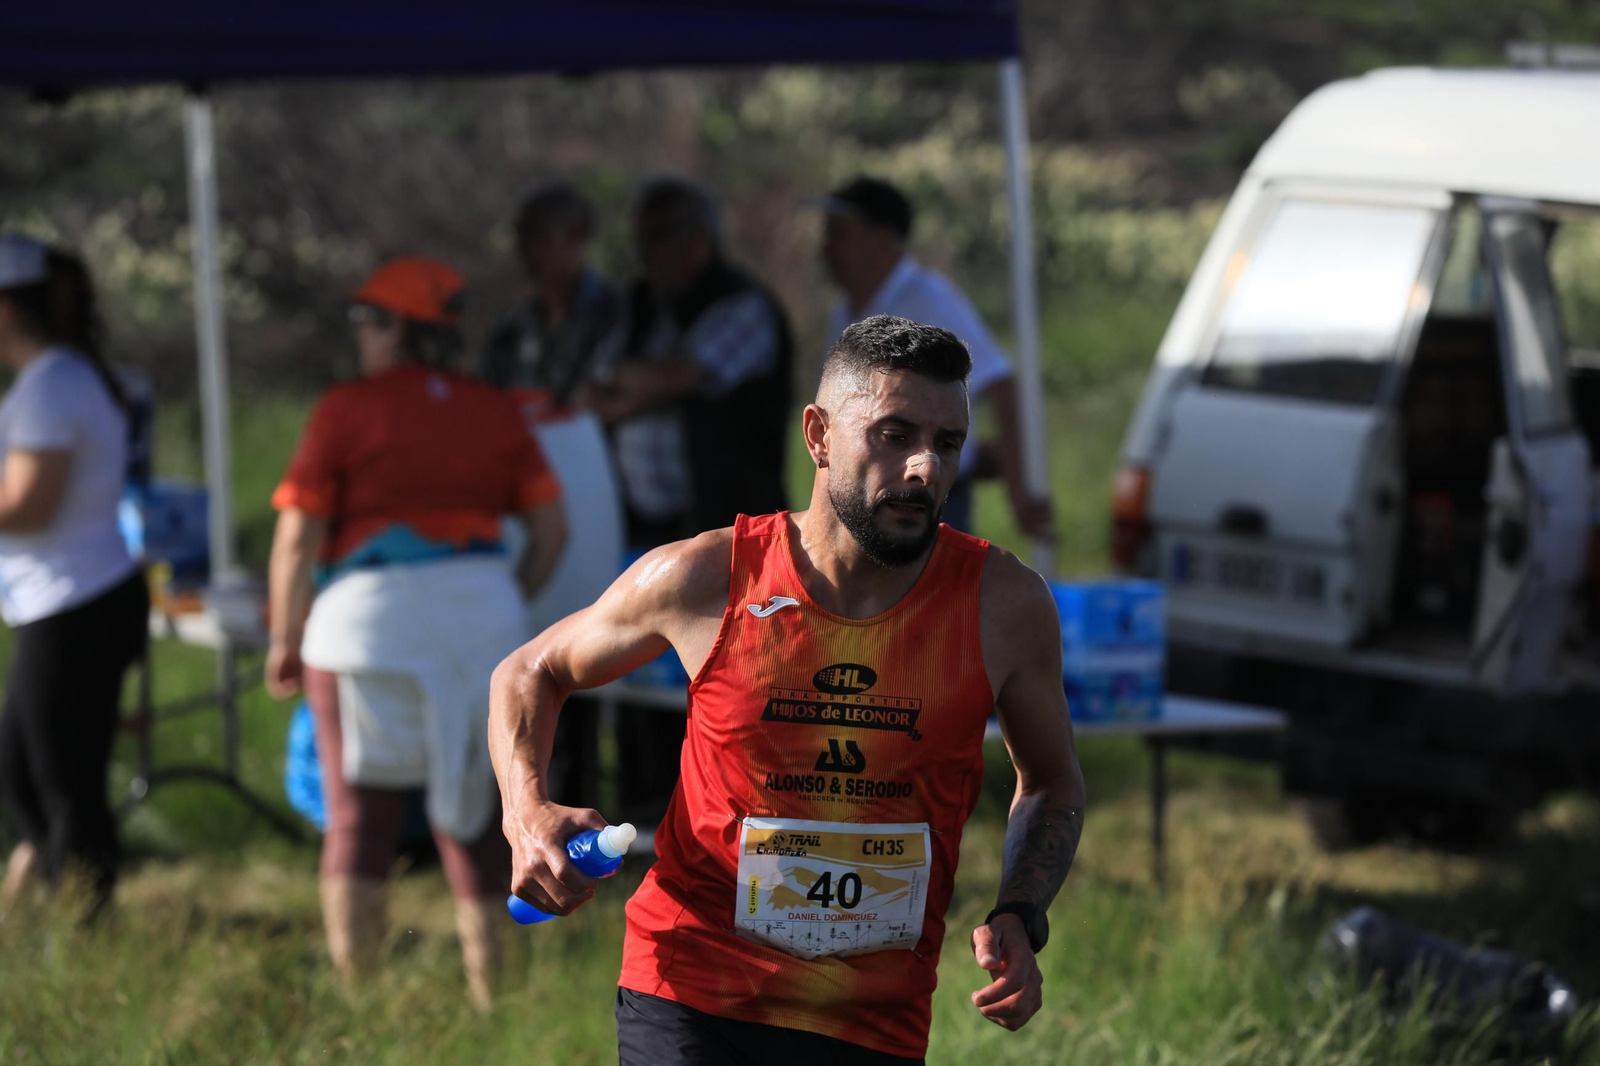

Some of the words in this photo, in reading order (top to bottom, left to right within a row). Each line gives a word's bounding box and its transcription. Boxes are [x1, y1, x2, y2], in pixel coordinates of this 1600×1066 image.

[832, 668, 869, 688] HL
[777, 691, 915, 708] TRANSPORTES
[771, 702, 817, 719] HIJOS
[821, 705, 841, 719] de
[845, 707, 911, 725] LEONOR
[765, 773, 826, 793] ALONSO
[830, 776, 841, 794] &
[845, 778, 914, 798] SERODIO
[789, 834, 822, 847] TRAIL
[862, 839, 905, 856] CH35
[806, 871, 863, 910] 40
[788, 912, 822, 922] DANIEL
[824, 913, 878, 922] DOMINGUEZ
